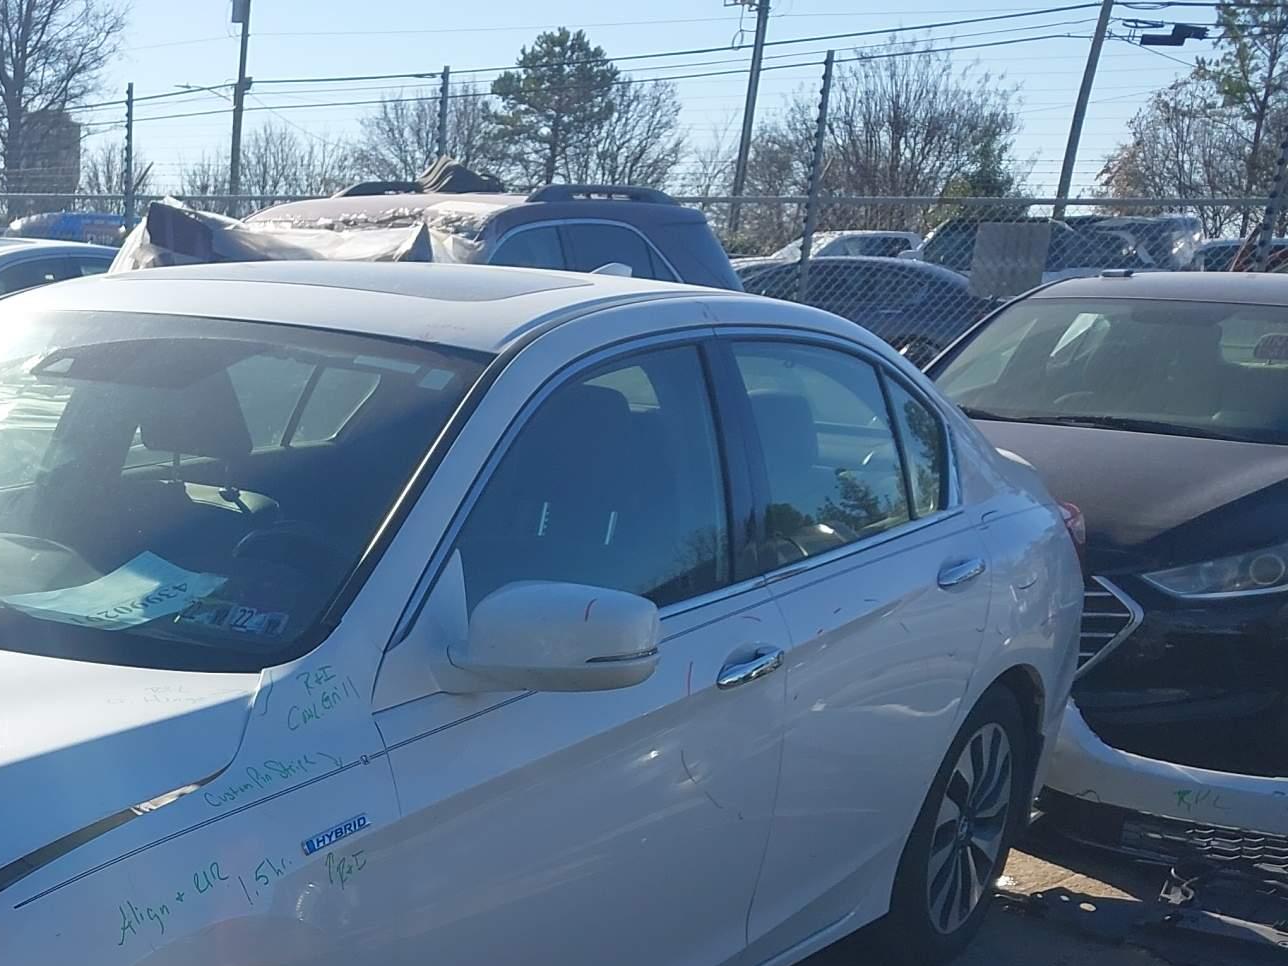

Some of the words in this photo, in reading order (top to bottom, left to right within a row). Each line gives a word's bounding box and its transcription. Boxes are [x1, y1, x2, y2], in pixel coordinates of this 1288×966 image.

[231, 608, 255, 629] 22
[315, 815, 367, 848] HYBRID
[118, 899, 171, 946] Align
